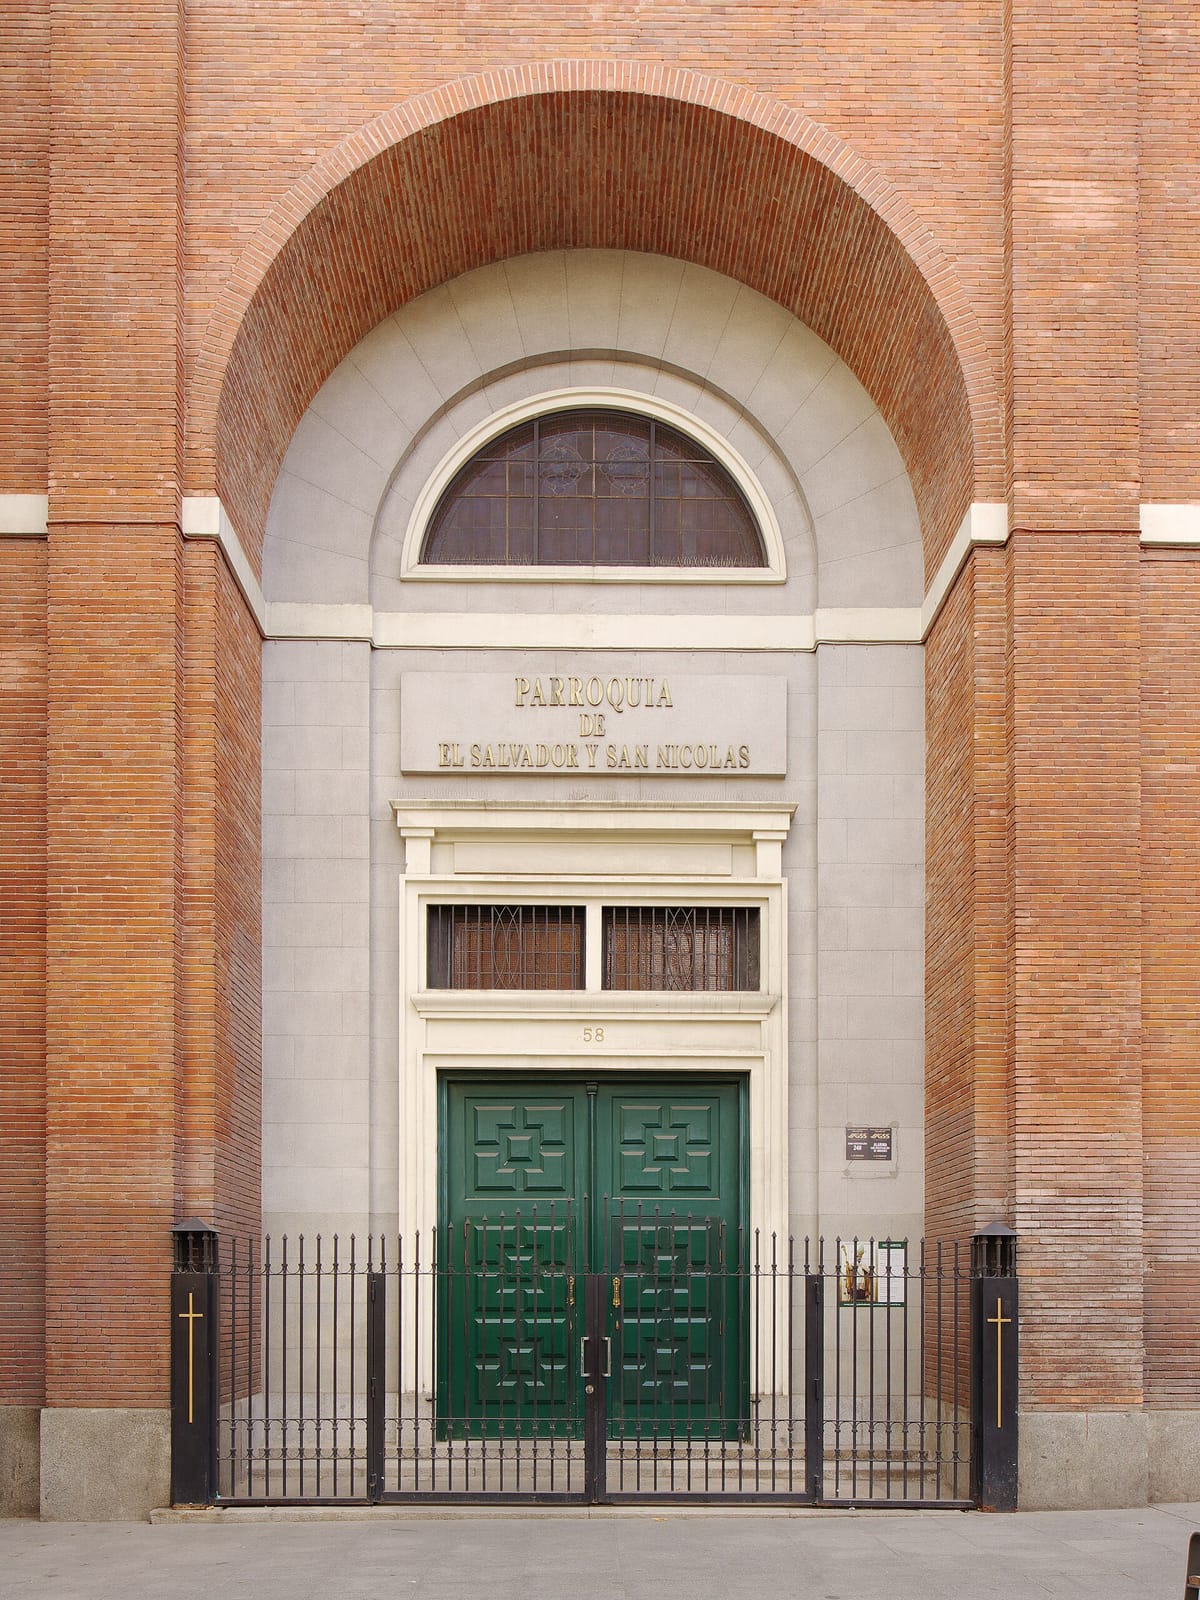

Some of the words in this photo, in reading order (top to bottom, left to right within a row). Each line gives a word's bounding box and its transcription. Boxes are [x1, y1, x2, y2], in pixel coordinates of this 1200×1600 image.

[514, 677, 673, 712] PARROQUIA
[579, 713, 606, 737] DE
[438, 743, 464, 767] EL
[471, 743, 579, 768] SALVADOR
[585, 743, 600, 768] Y
[606, 744, 649, 768] SAN
[656, 744, 751, 768] NICOLAS
[583, 1027, 605, 1042] 58
